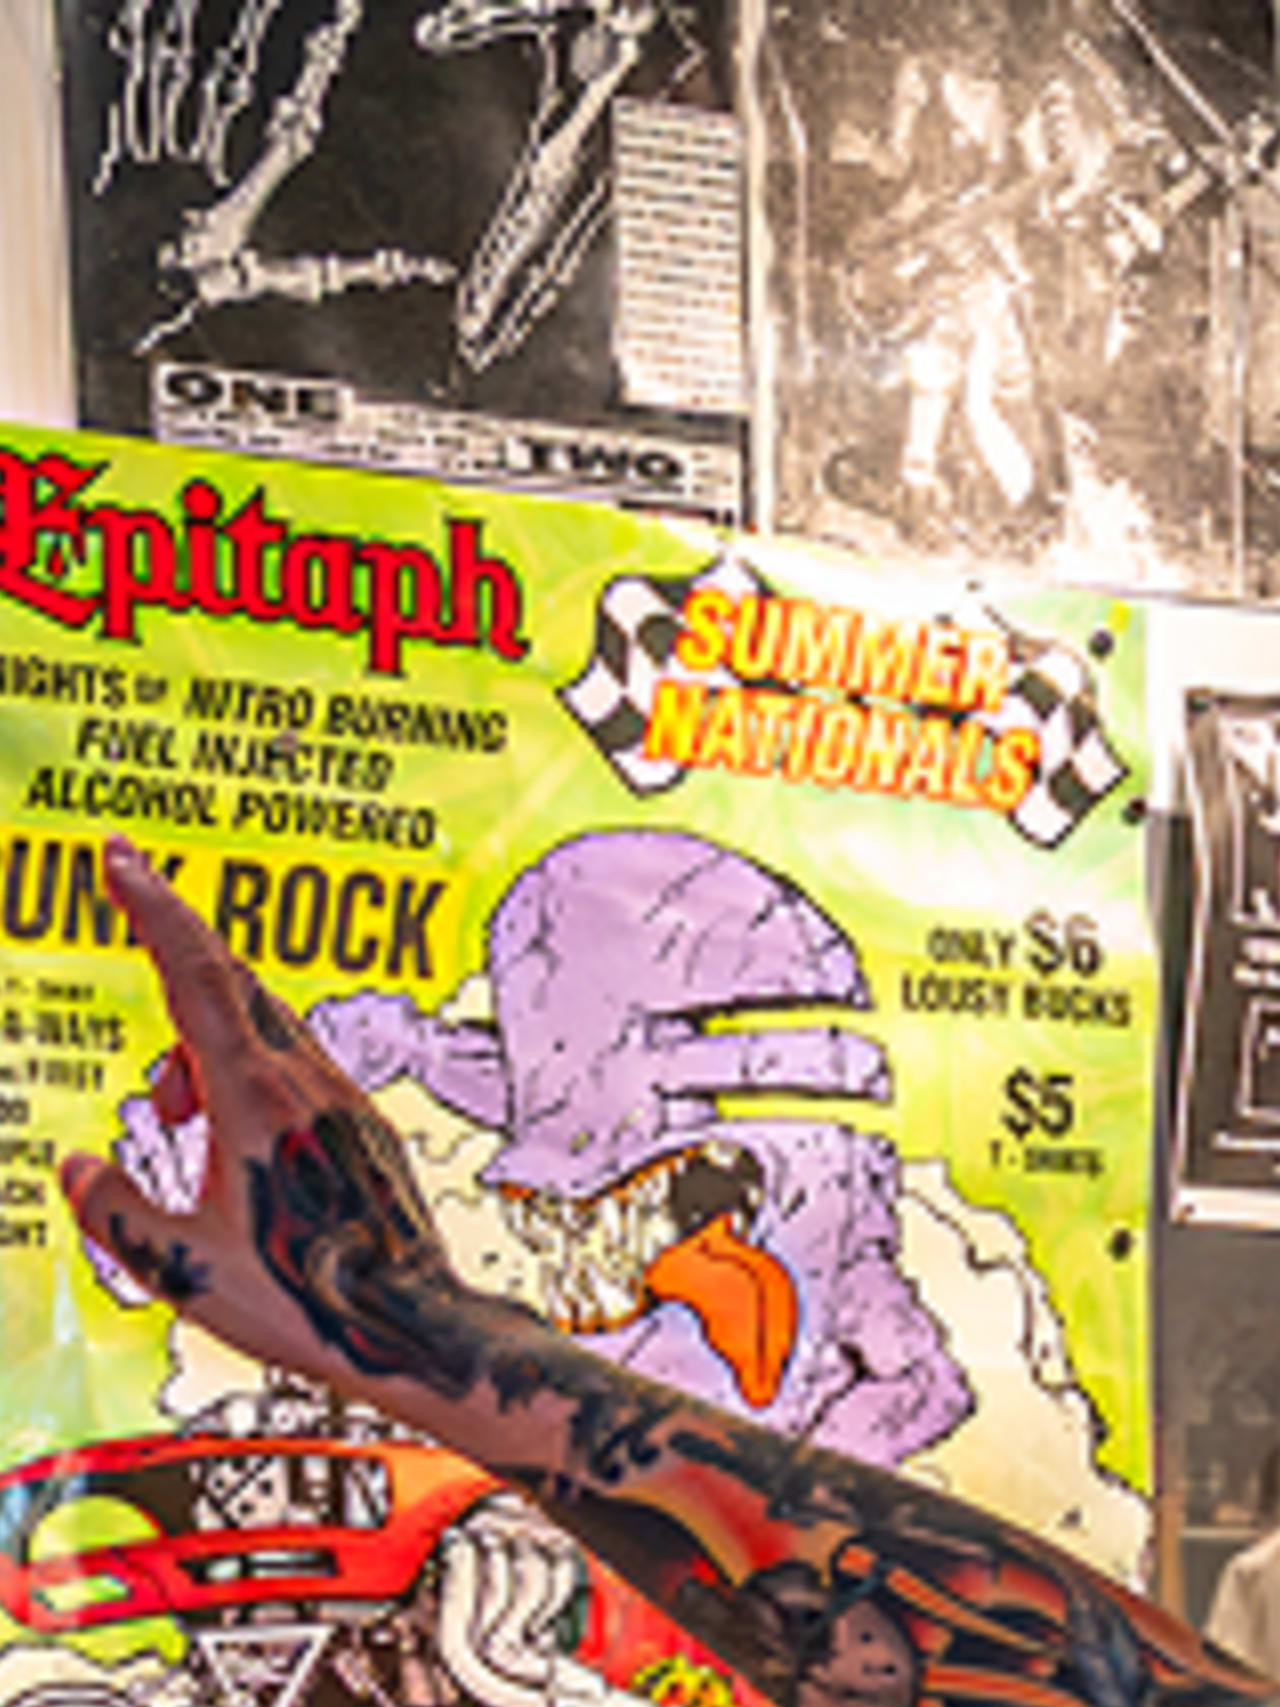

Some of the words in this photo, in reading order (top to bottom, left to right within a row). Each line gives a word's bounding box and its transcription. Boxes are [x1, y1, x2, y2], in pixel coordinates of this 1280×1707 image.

[164, 369, 340, 420] ONE
[526, 436, 684, 484] TWO
[675, 588, 1011, 714] SUMMER
[183, 676, 313, 730] NITRO
[325, 692, 509, 756] BURNING
[642, 678, 1043, 814] NATIONALS
[77, 720, 178, 771] FUEL
[191, 731, 395, 795] INJECTED
[25, 768, 219, 828] ALCOHOL
[231, 790, 438, 852] POWERED
[217, 858, 450, 980] ROCK
[927, 926, 1018, 970] ONLY
[1023, 910, 1105, 979] $6
[901, 976, 1011, 1019] LOUSY
[1022, 982, 1132, 1028] BUCKS
[1000, 1066, 1077, 1142] $5
